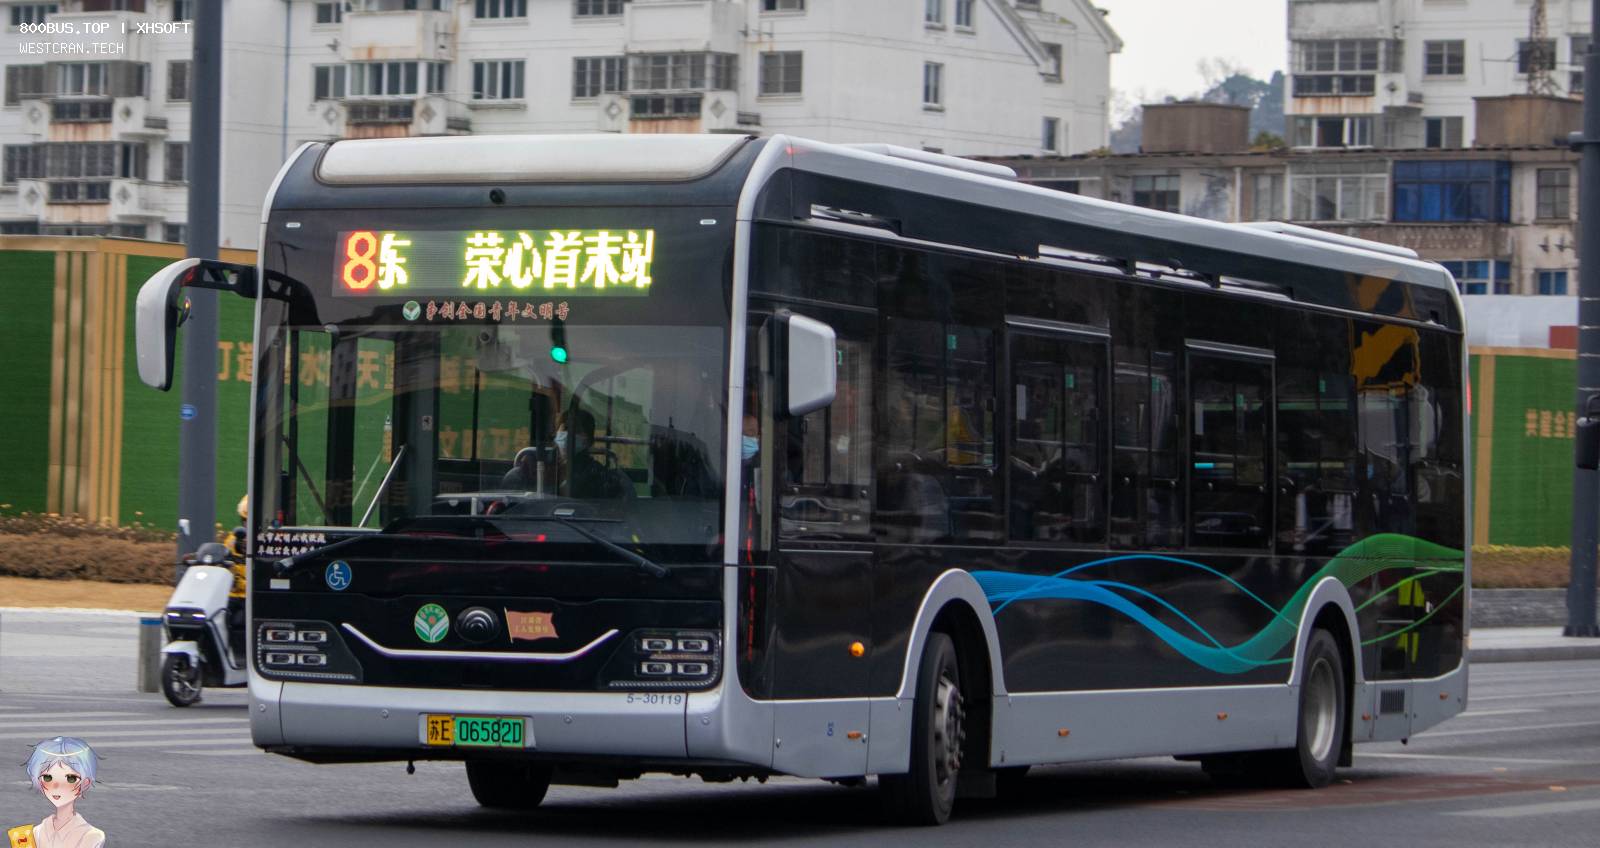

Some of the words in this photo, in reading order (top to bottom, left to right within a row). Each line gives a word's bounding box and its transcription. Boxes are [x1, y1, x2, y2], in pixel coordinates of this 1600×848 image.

[426, 300, 570, 321] 争创全国青年文明号
[627, 693, 682, 705] 5-30119
